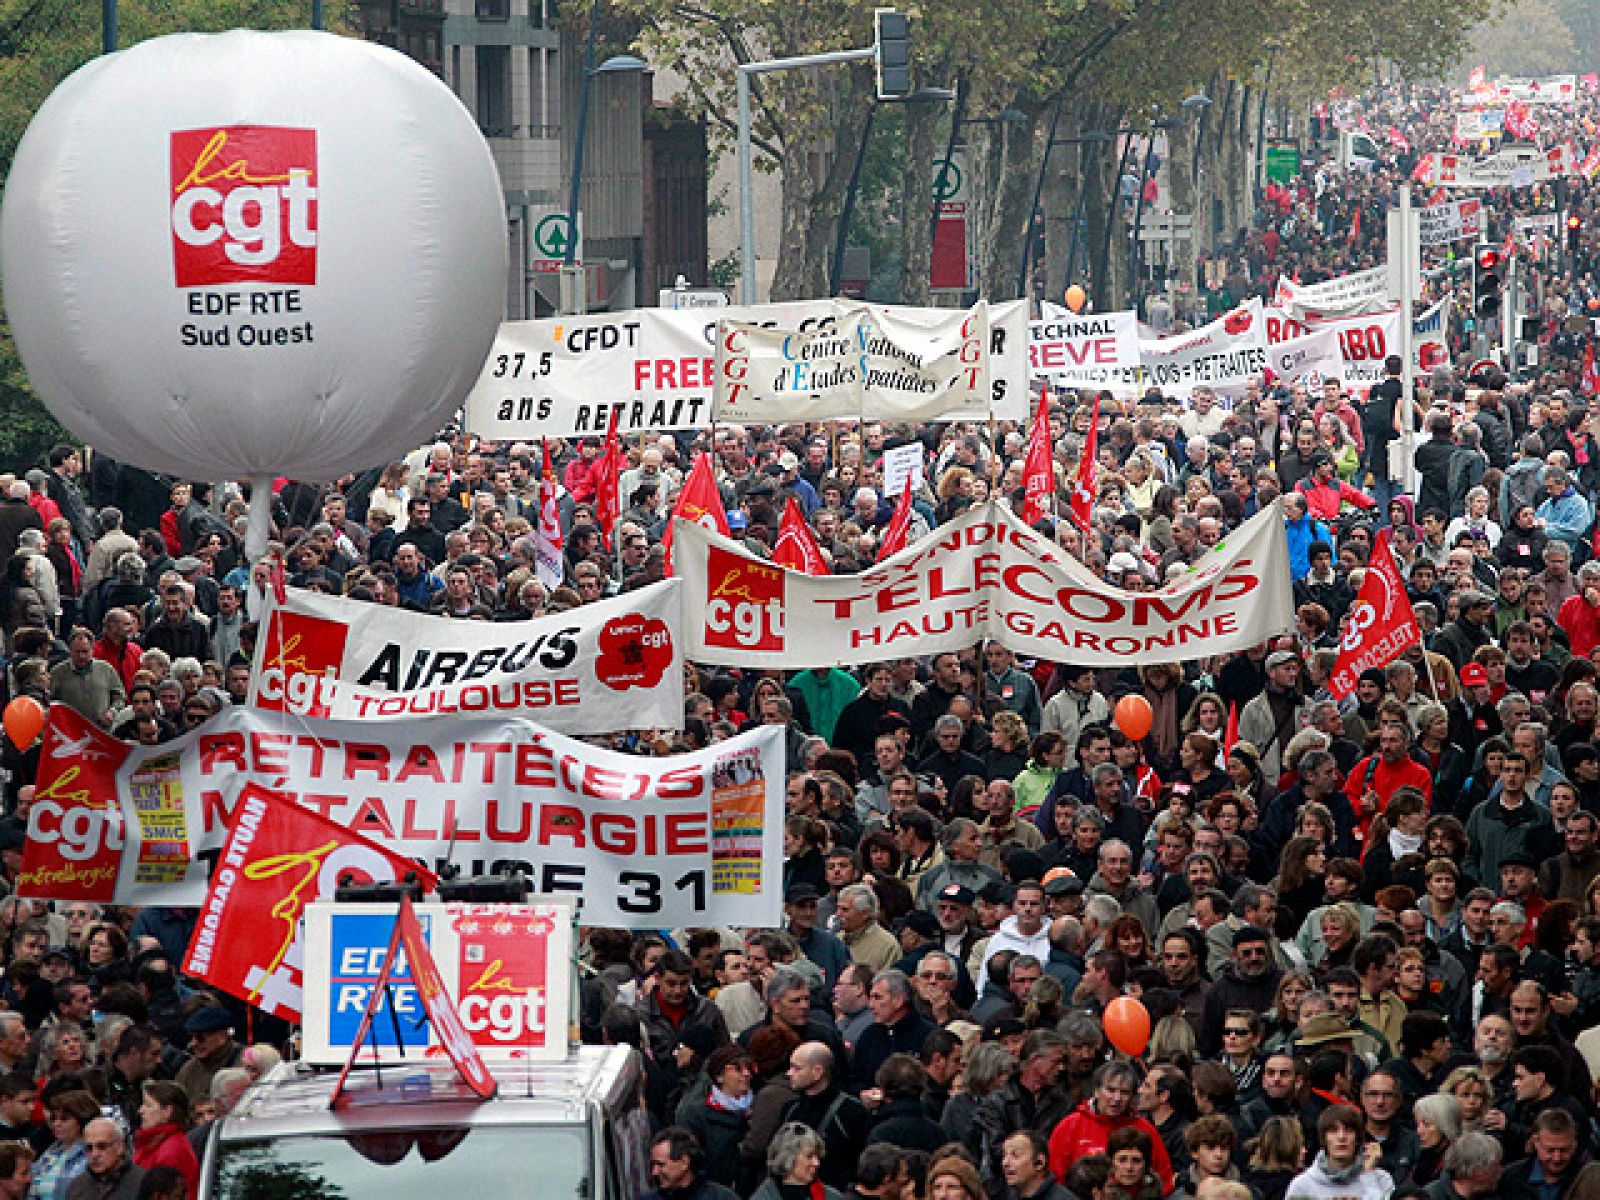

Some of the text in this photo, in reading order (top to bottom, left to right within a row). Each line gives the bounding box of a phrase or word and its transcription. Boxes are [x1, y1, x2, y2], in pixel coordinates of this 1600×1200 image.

[175, 130, 313, 193] la
[174, 168, 317, 265] cgt
[188, 289, 302, 315] EDF RTE
[181, 321, 314, 346] Sud Ouest
[566, 322, 641, 352] CFDT
[1029, 318, 1116, 341] ECHNAL
[783, 334, 851, 361] Centre
[1193, 347, 1266, 381] RETRAITES
[493, 352, 553, 381] 37,5
[497, 398, 553, 421] ans
[574, 397, 715, 431] RETRAIT
[692, 567, 766, 603] la
[708, 597, 786, 646] cgt
[642, 629, 669, 649] cgt
[356, 626, 581, 692] AIRBUS
[260, 667, 341, 715] cgt
[352, 678, 581, 719] TOULOUSE
[27, 799, 127, 861] cgt
[200, 777, 708, 857] MTALLURGIE
[616, 869, 707, 914] 31
[468, 960, 545, 993] la
[336, 985, 416, 1013] RTE
[458, 988, 545, 1042] cgt
